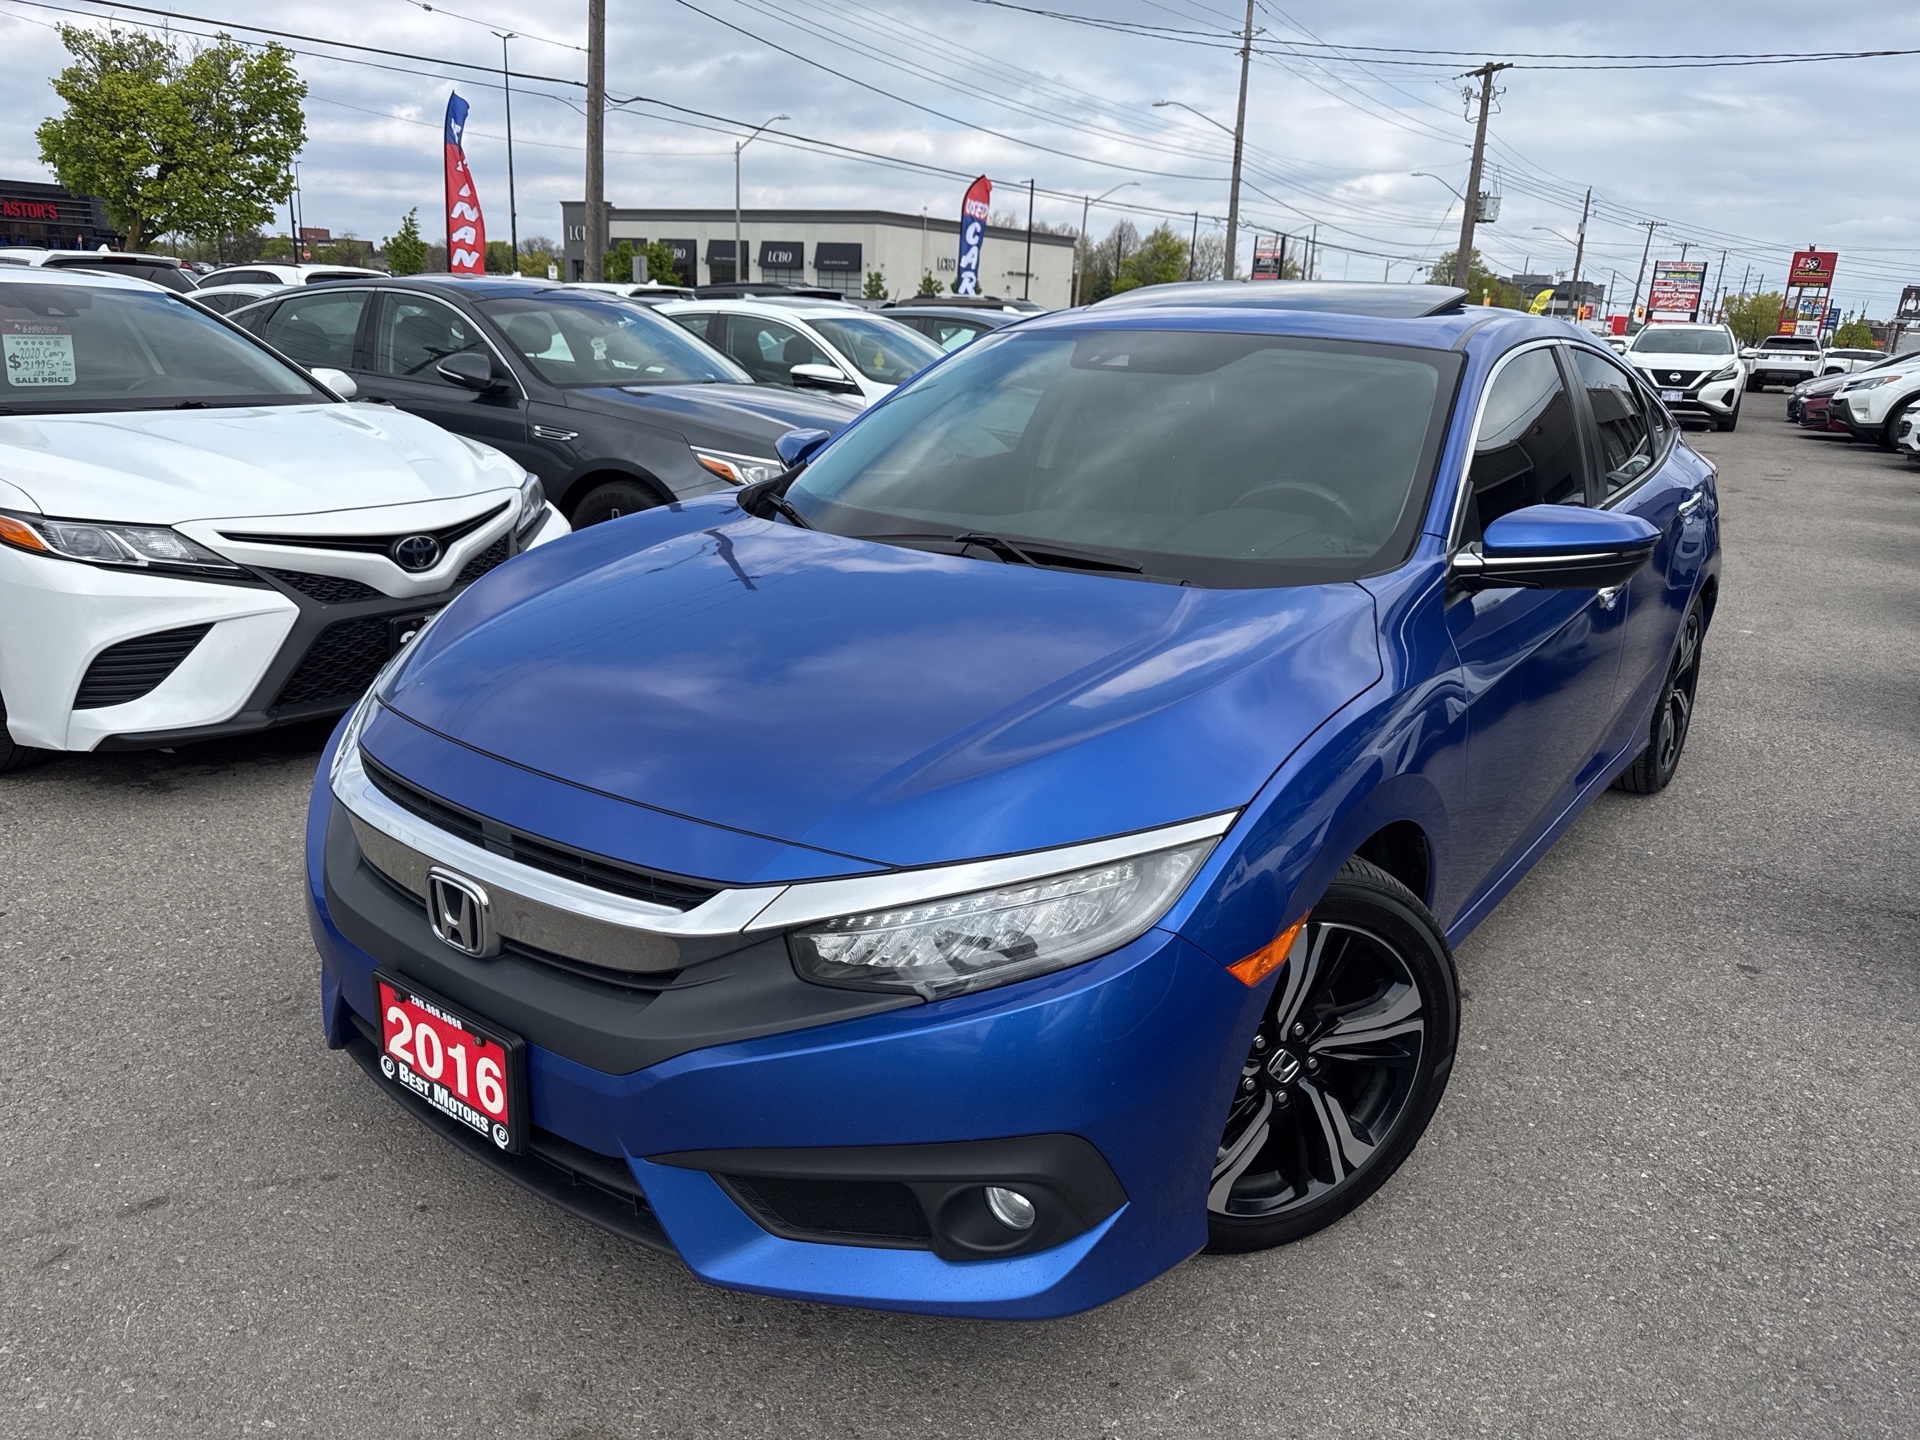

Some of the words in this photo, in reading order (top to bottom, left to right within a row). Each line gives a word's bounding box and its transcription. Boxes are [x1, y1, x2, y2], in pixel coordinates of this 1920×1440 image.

[3, 201, 58, 220] ASTOR'S
[965, 198, 988, 220] USED
[767, 250, 793, 263] LCBO
[937, 256, 956, 272] LCBO
[1671, 291, 1696, 299] Choice
[8, 352, 21, 371] $
[20, 348, 40, 360] 2020
[386, 1006, 504, 1114] 2016
